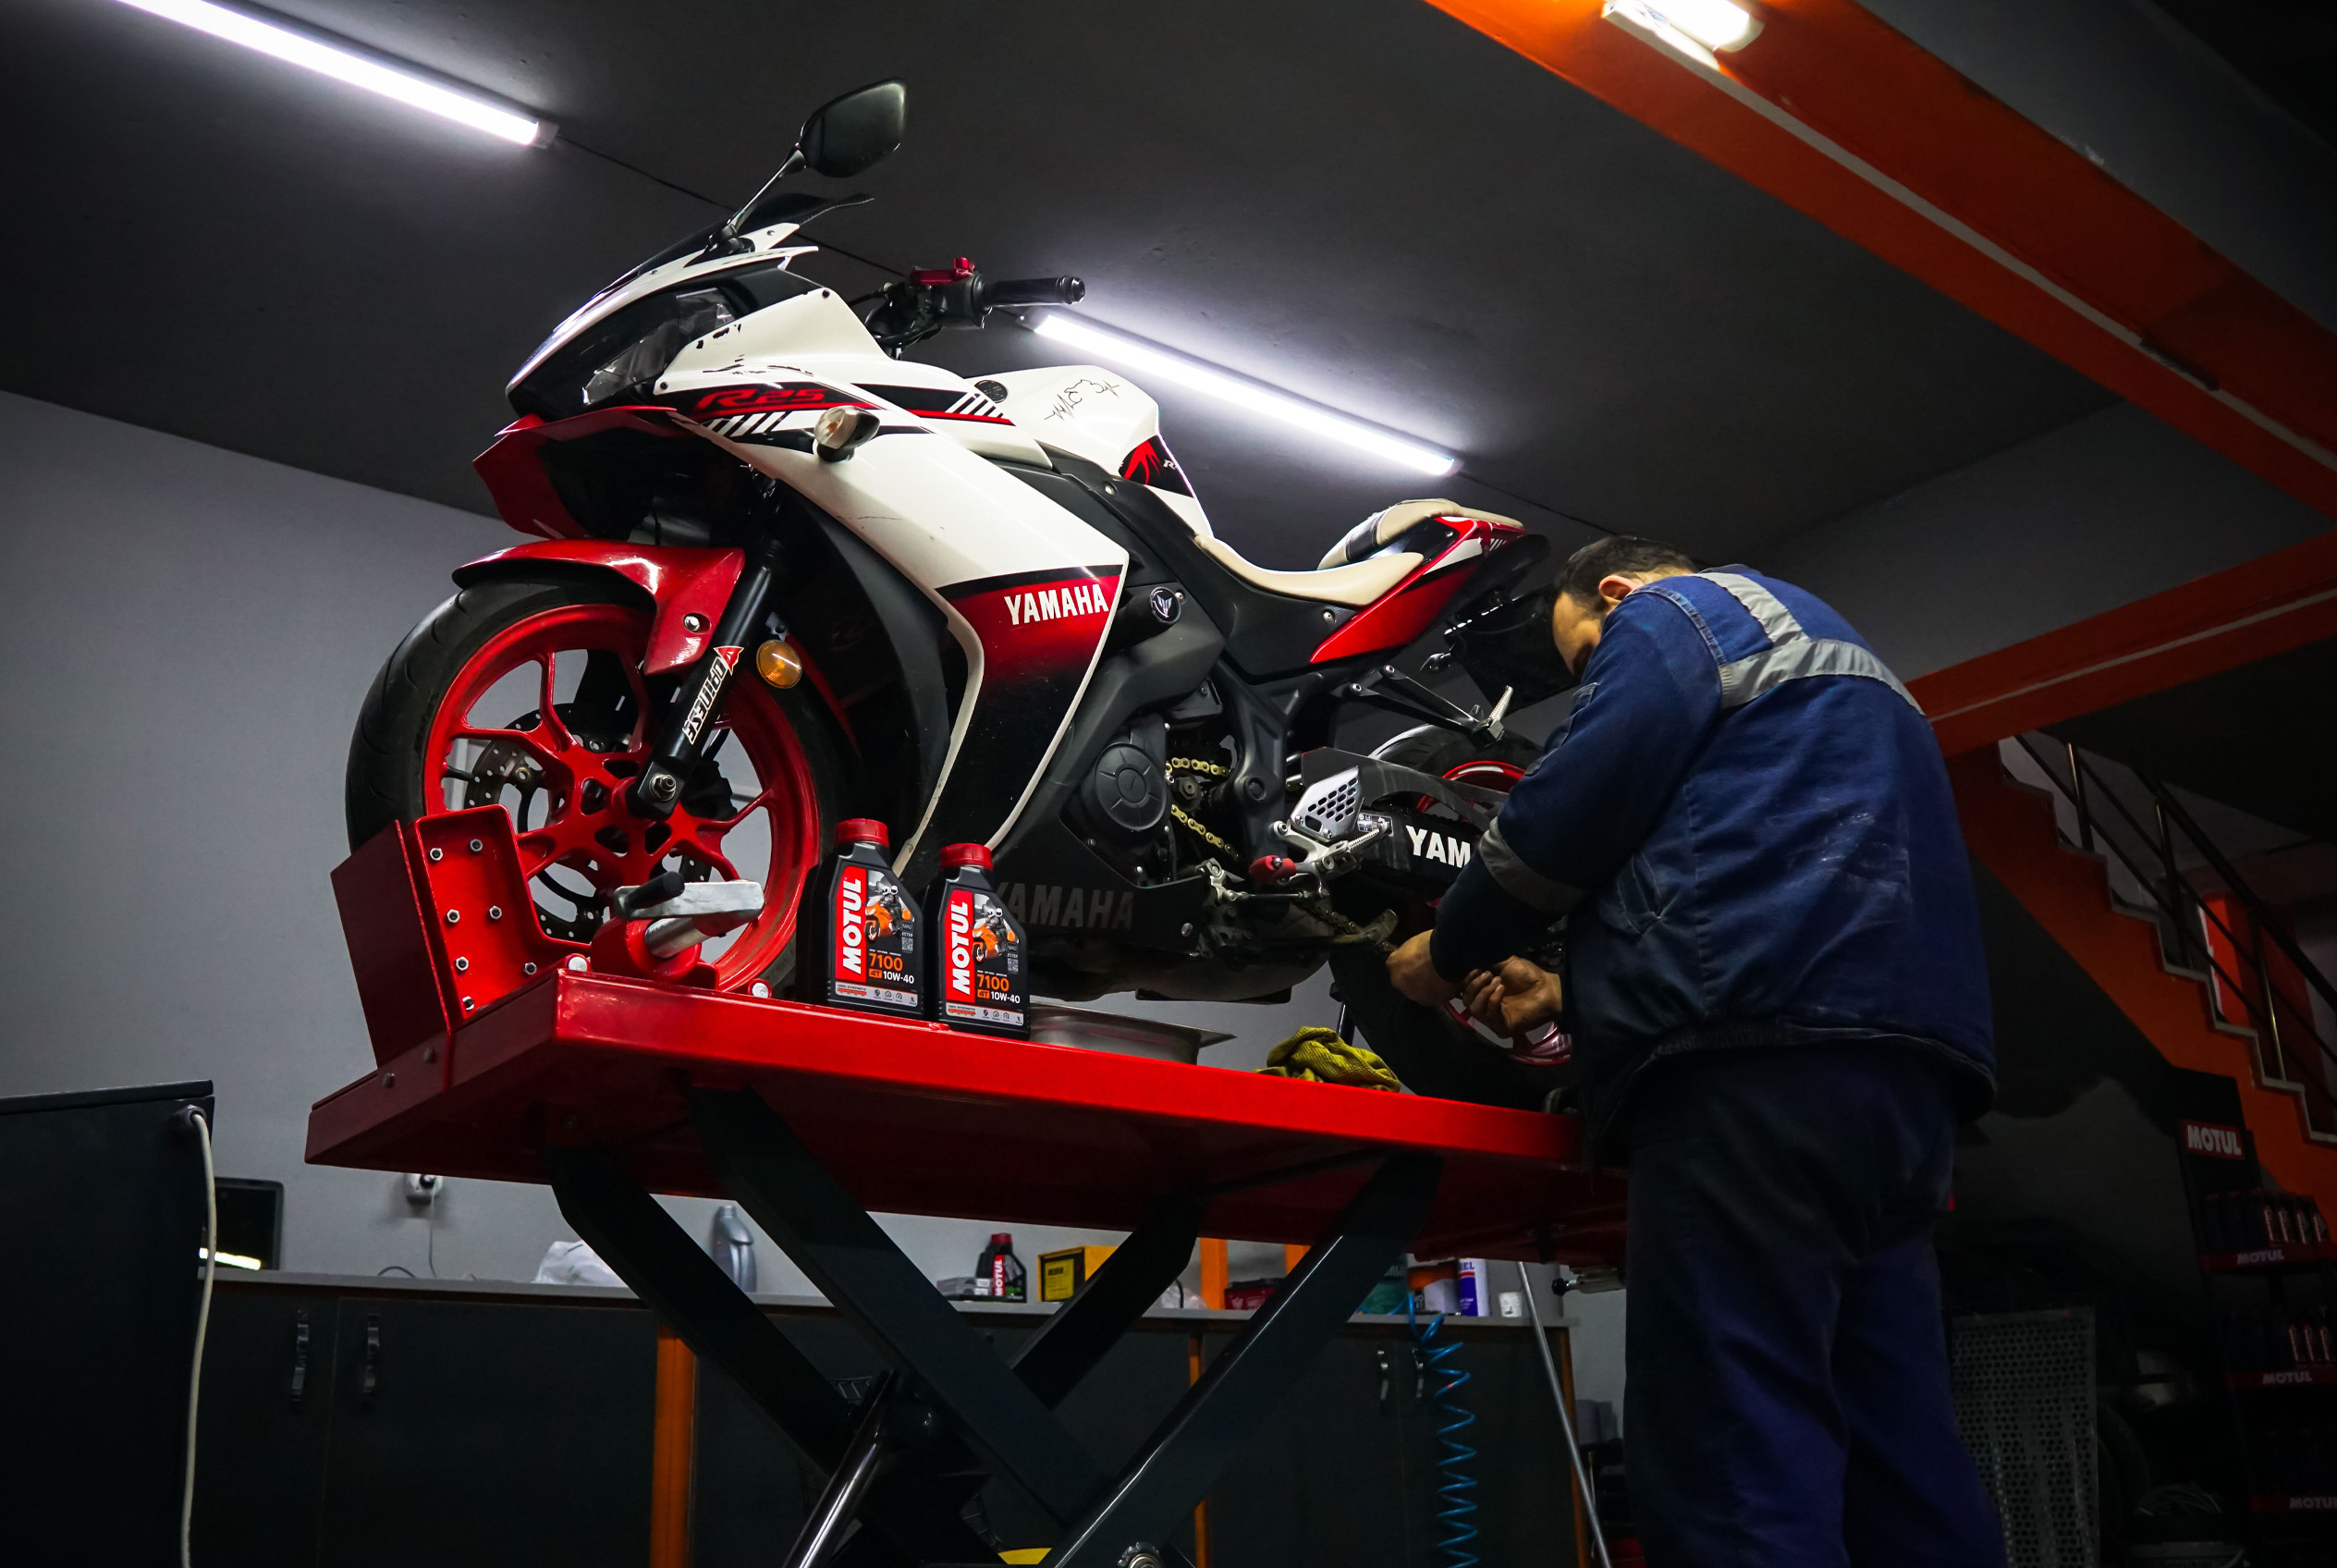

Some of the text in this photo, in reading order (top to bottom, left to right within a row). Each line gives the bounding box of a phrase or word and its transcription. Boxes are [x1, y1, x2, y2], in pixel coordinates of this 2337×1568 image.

[694, 388, 828, 411] R25
[1004, 583, 1109, 625] YAMAHA
[996, 881, 1134, 930] AMAHA
[843, 878, 862, 974] MOTUL
[951, 902, 971, 996] MOTUL
[869, 952, 903, 972] 7100
[883, 971, 914, 984] 10W-40
[976, 974, 1009, 992] 7100
[991, 991, 1021, 1004] 10W-40
[2187, 1124, 2242, 1156] MOTUL
[2237, 1249, 2285, 1265] MOTUL
[994, 1259, 1004, 1296] MOTUL
[2263, 1370, 2313, 1385] MOTUL
